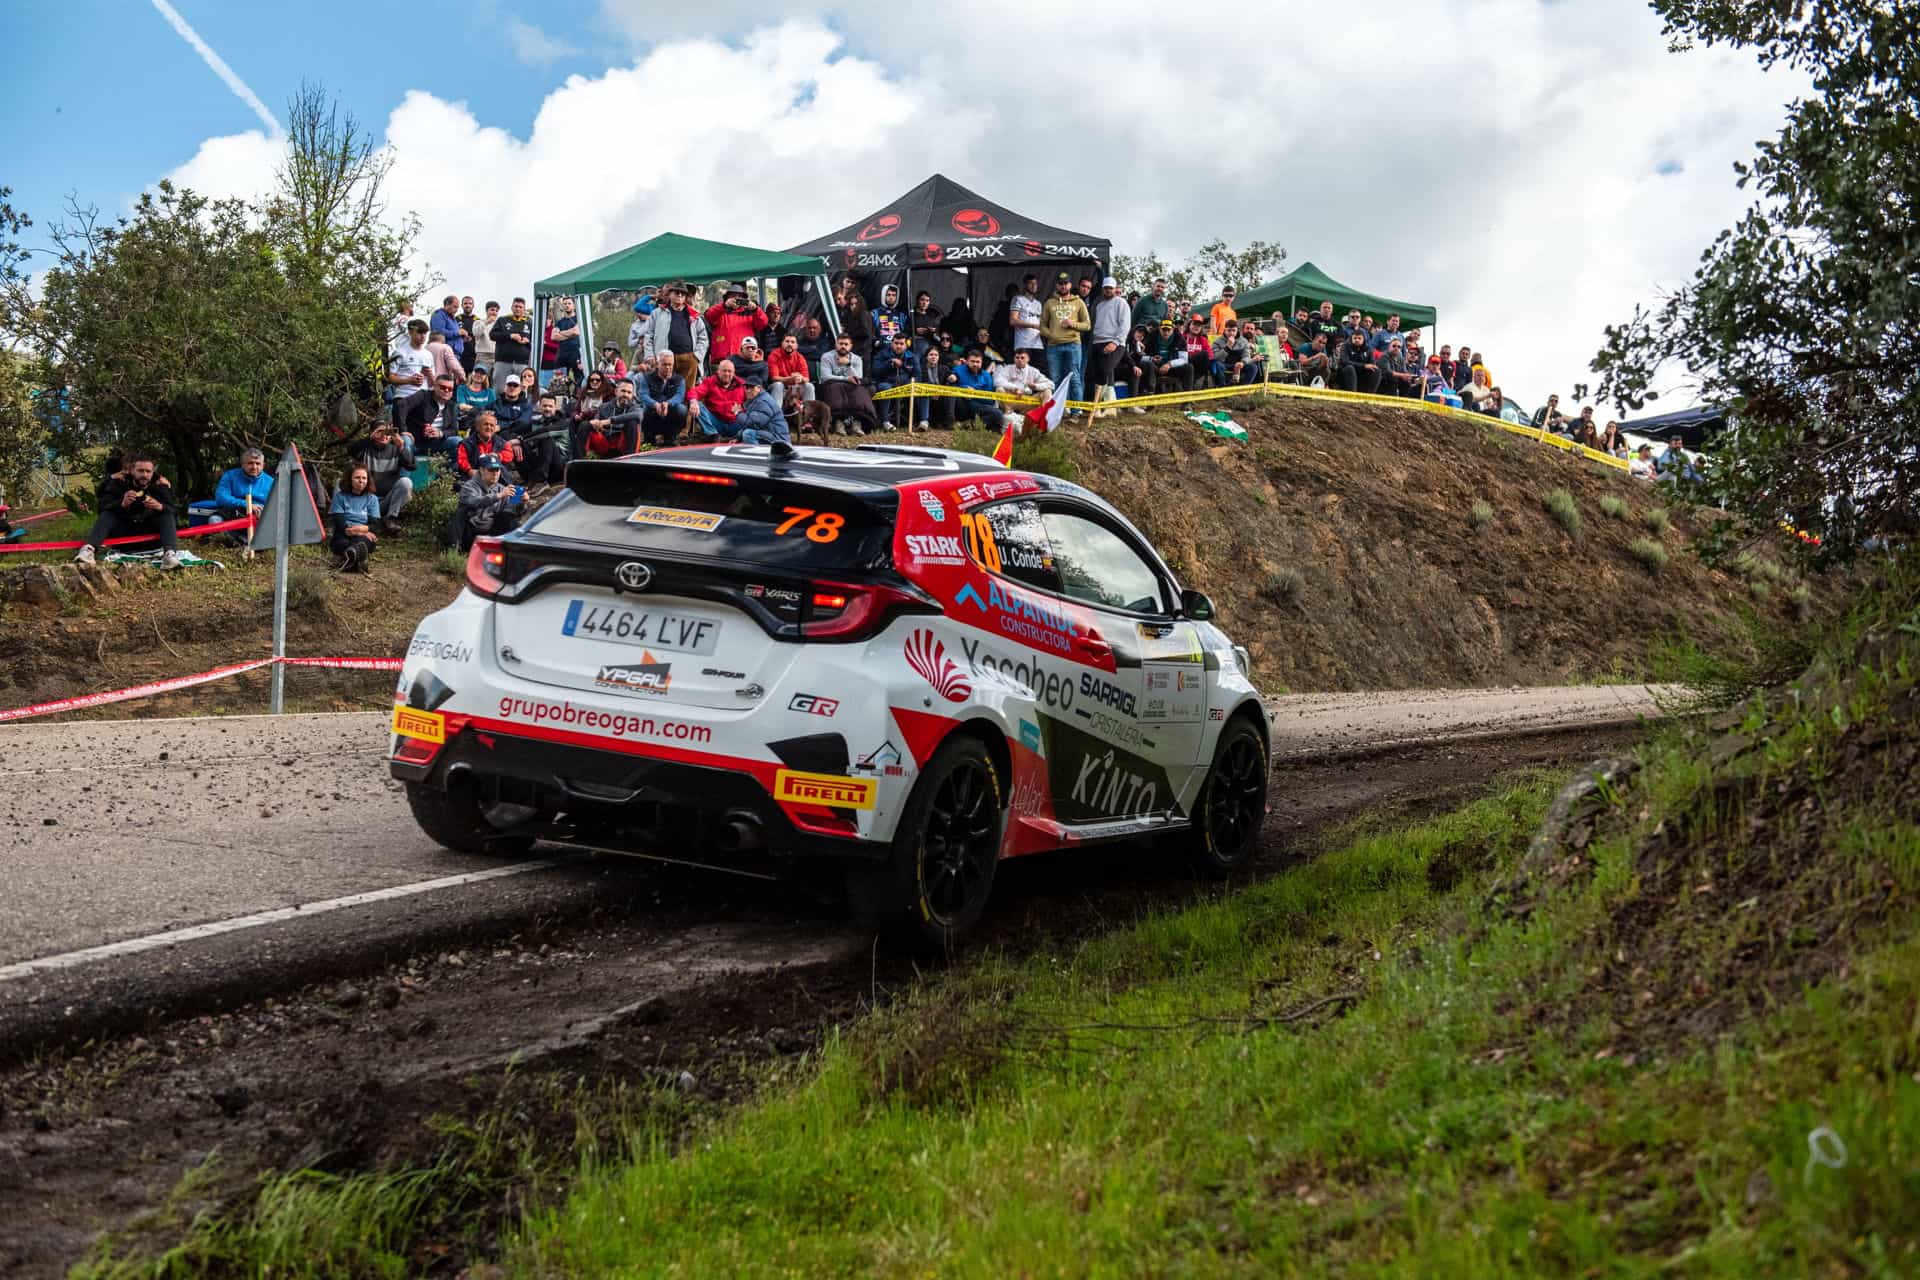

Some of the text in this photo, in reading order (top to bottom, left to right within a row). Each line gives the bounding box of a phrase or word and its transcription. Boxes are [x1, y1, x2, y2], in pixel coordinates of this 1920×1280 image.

[858, 254, 897, 266] 24MX
[946, 244, 1005, 259] 24MX
[1045, 245, 1099, 259] 24MX
[774, 506, 846, 543] 78
[906, 535, 964, 557] STARK
[959, 513, 1002, 574] 78
[1000, 545, 1043, 569] U. Conde
[582, 607, 713, 649] 4464 LVF
[1000, 615, 1072, 652] CONSTRUCTORA
[602, 666, 668, 689] YPGAL
[788, 693, 840, 717] GR
[1209, 709, 1224, 721] GR
[398, 711, 440, 737] PIRELLI
[499, 696, 712, 743] grupobreogan.com
[783, 775, 868, 803] PIRELLI
